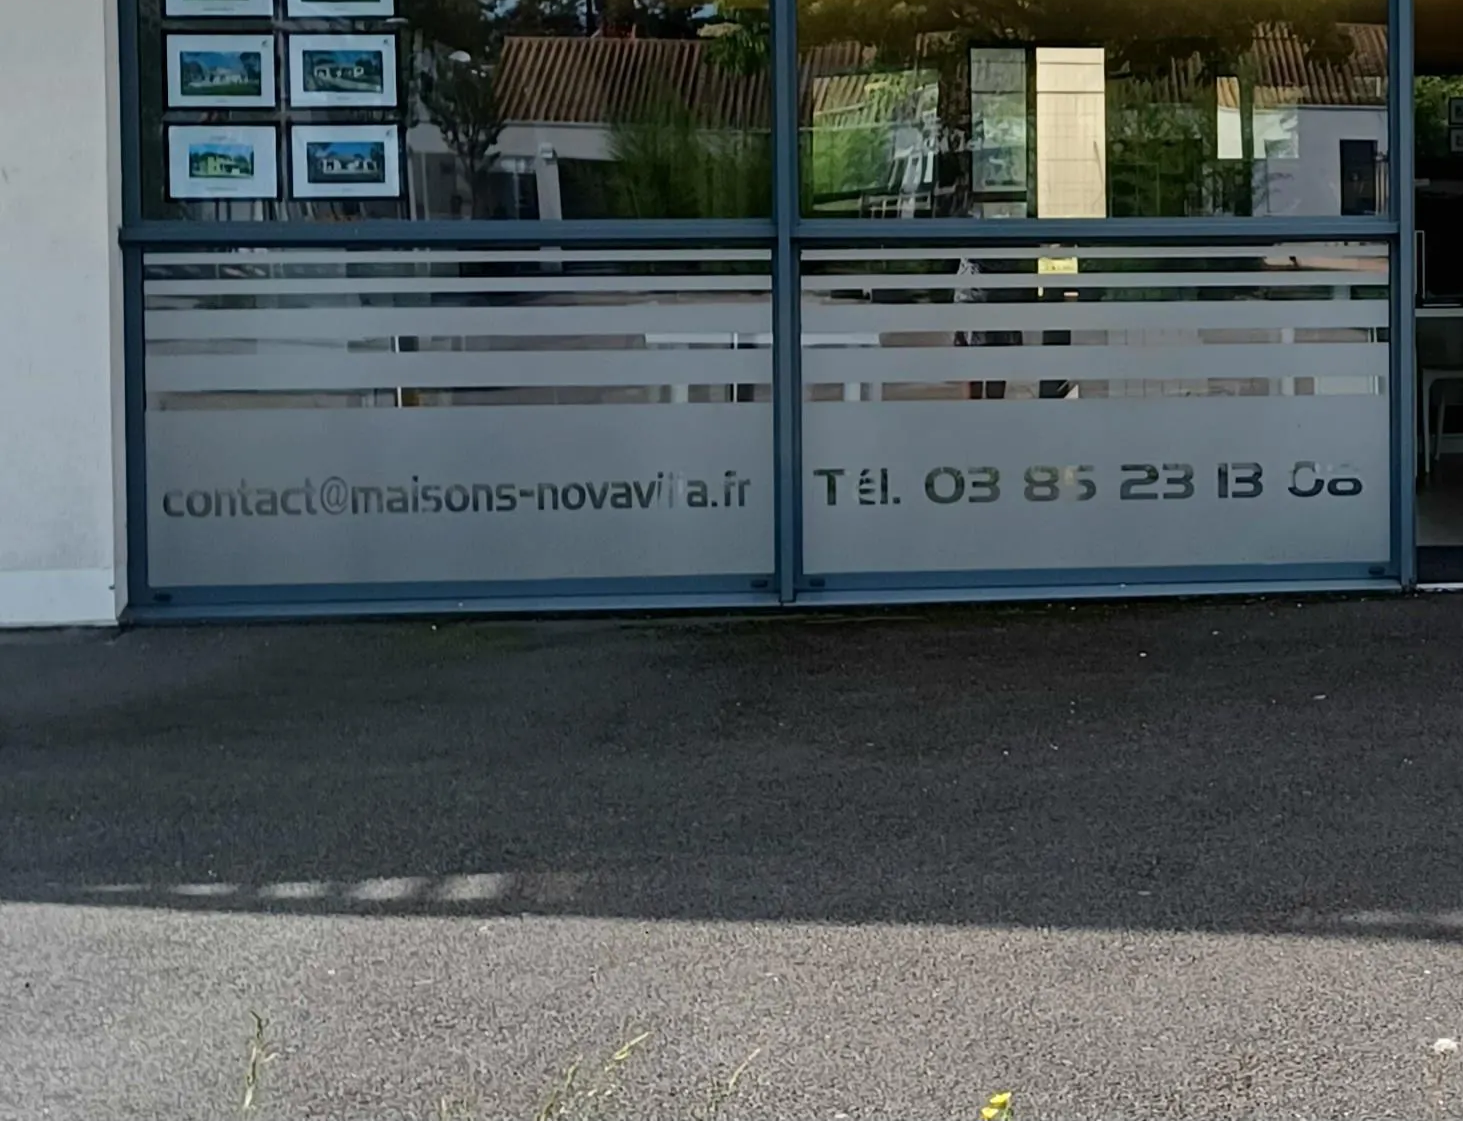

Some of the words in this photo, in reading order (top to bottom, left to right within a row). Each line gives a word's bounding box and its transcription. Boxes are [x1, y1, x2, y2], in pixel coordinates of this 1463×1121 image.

[162, 469, 752, 518] contact@maisons-novavila.fr
[813, 467, 901, 506] Tél.
[924, 465, 1001, 505] 03
[1119, 462, 1195, 501] 23
[1216, 461, 1264, 500] 13
